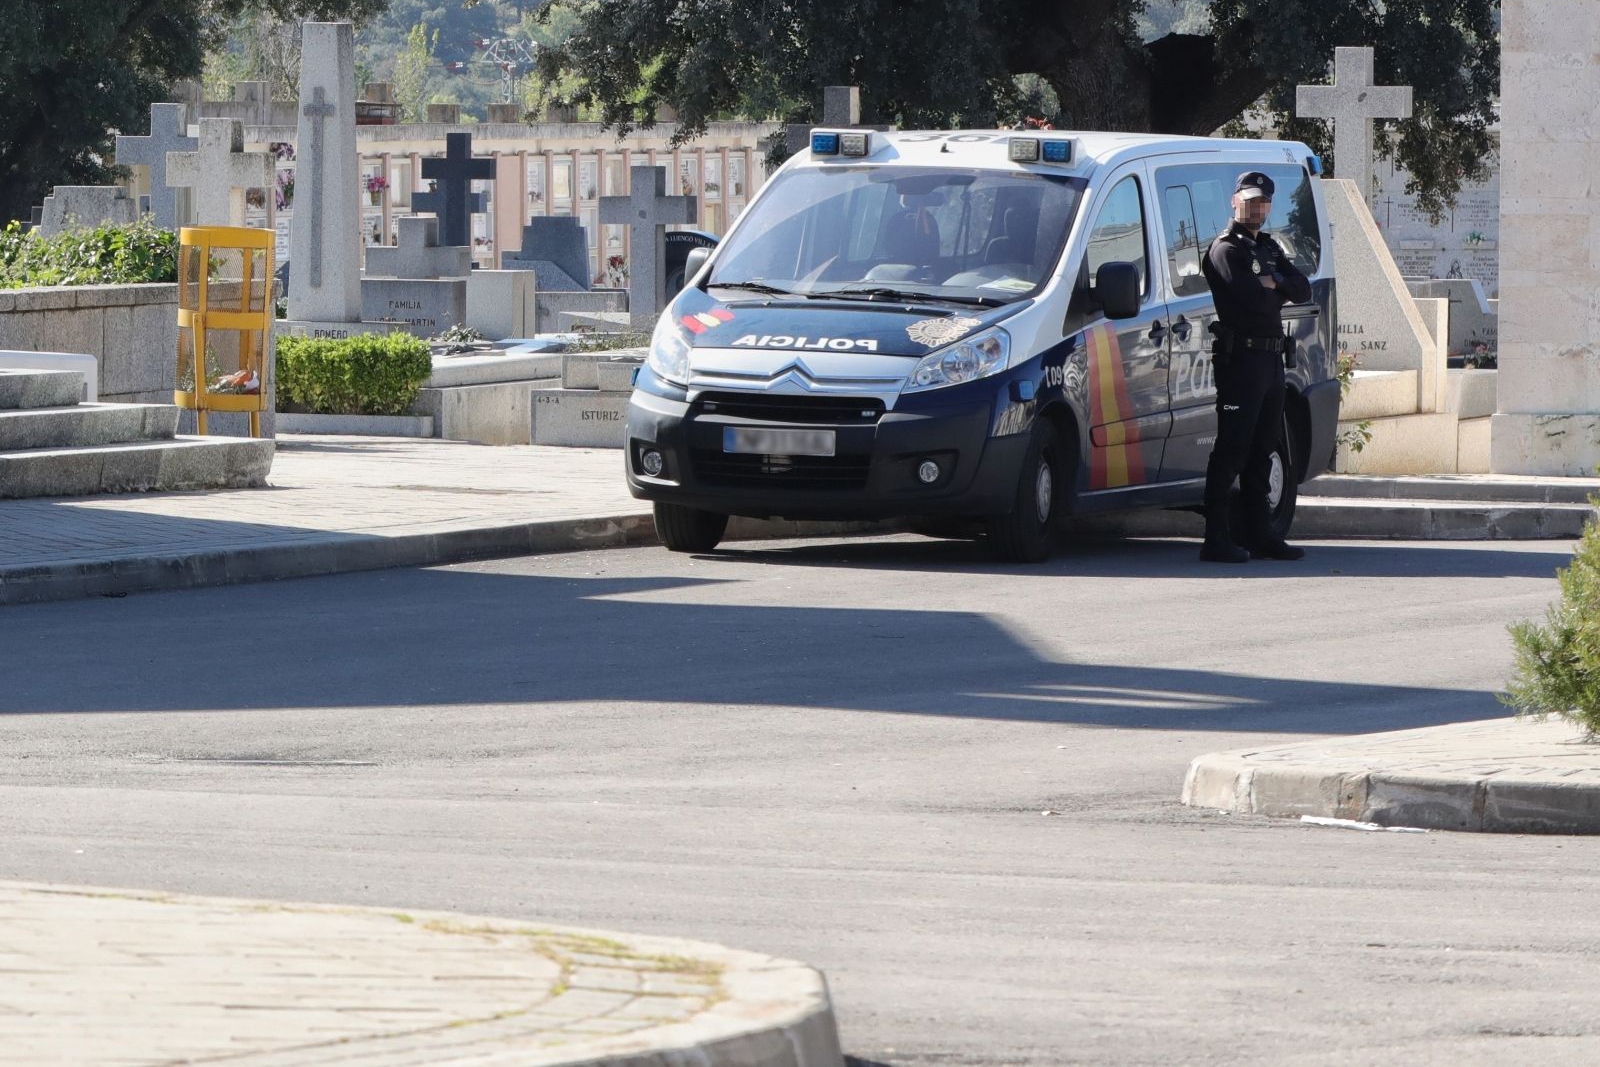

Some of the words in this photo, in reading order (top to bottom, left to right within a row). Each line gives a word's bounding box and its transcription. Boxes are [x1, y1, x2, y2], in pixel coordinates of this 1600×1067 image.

[389, 300, 422, 309] FAMILIA
[1336, 324, 1364, 334] MILIA
[1361, 340, 1387, 351] SANZ
[1175, 350, 1218, 401] POL
